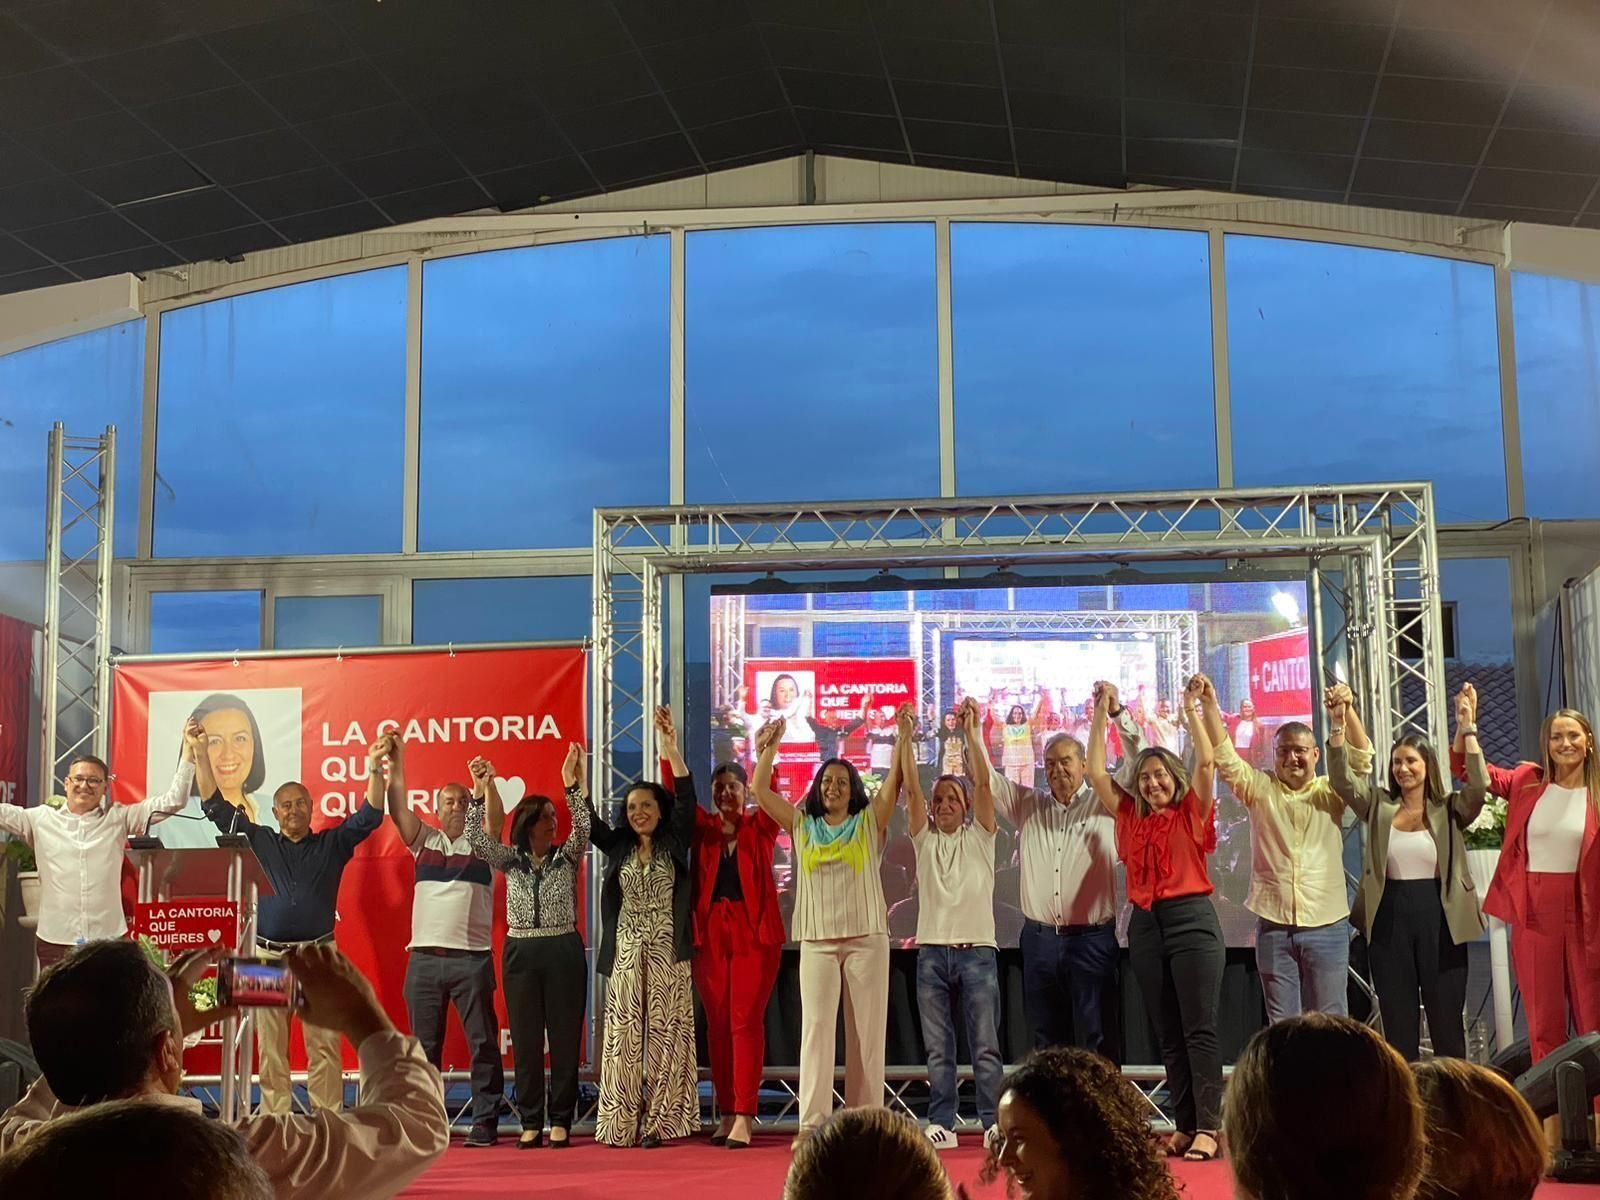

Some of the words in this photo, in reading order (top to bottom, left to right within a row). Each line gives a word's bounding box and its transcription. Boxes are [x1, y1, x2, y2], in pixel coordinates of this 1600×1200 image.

[1262, 656, 1311, 693] CANTO
[820, 684, 839, 695] LA
[840, 683, 908, 694] CANTORIA
[820, 697, 849, 707] QUE
[322, 721, 367, 746] LA
[149, 909, 166, 920] LA
[168, 907, 234, 919] CANTORIA
[149, 921, 176, 932] QUE
[149, 933, 205, 945] QUIERES
